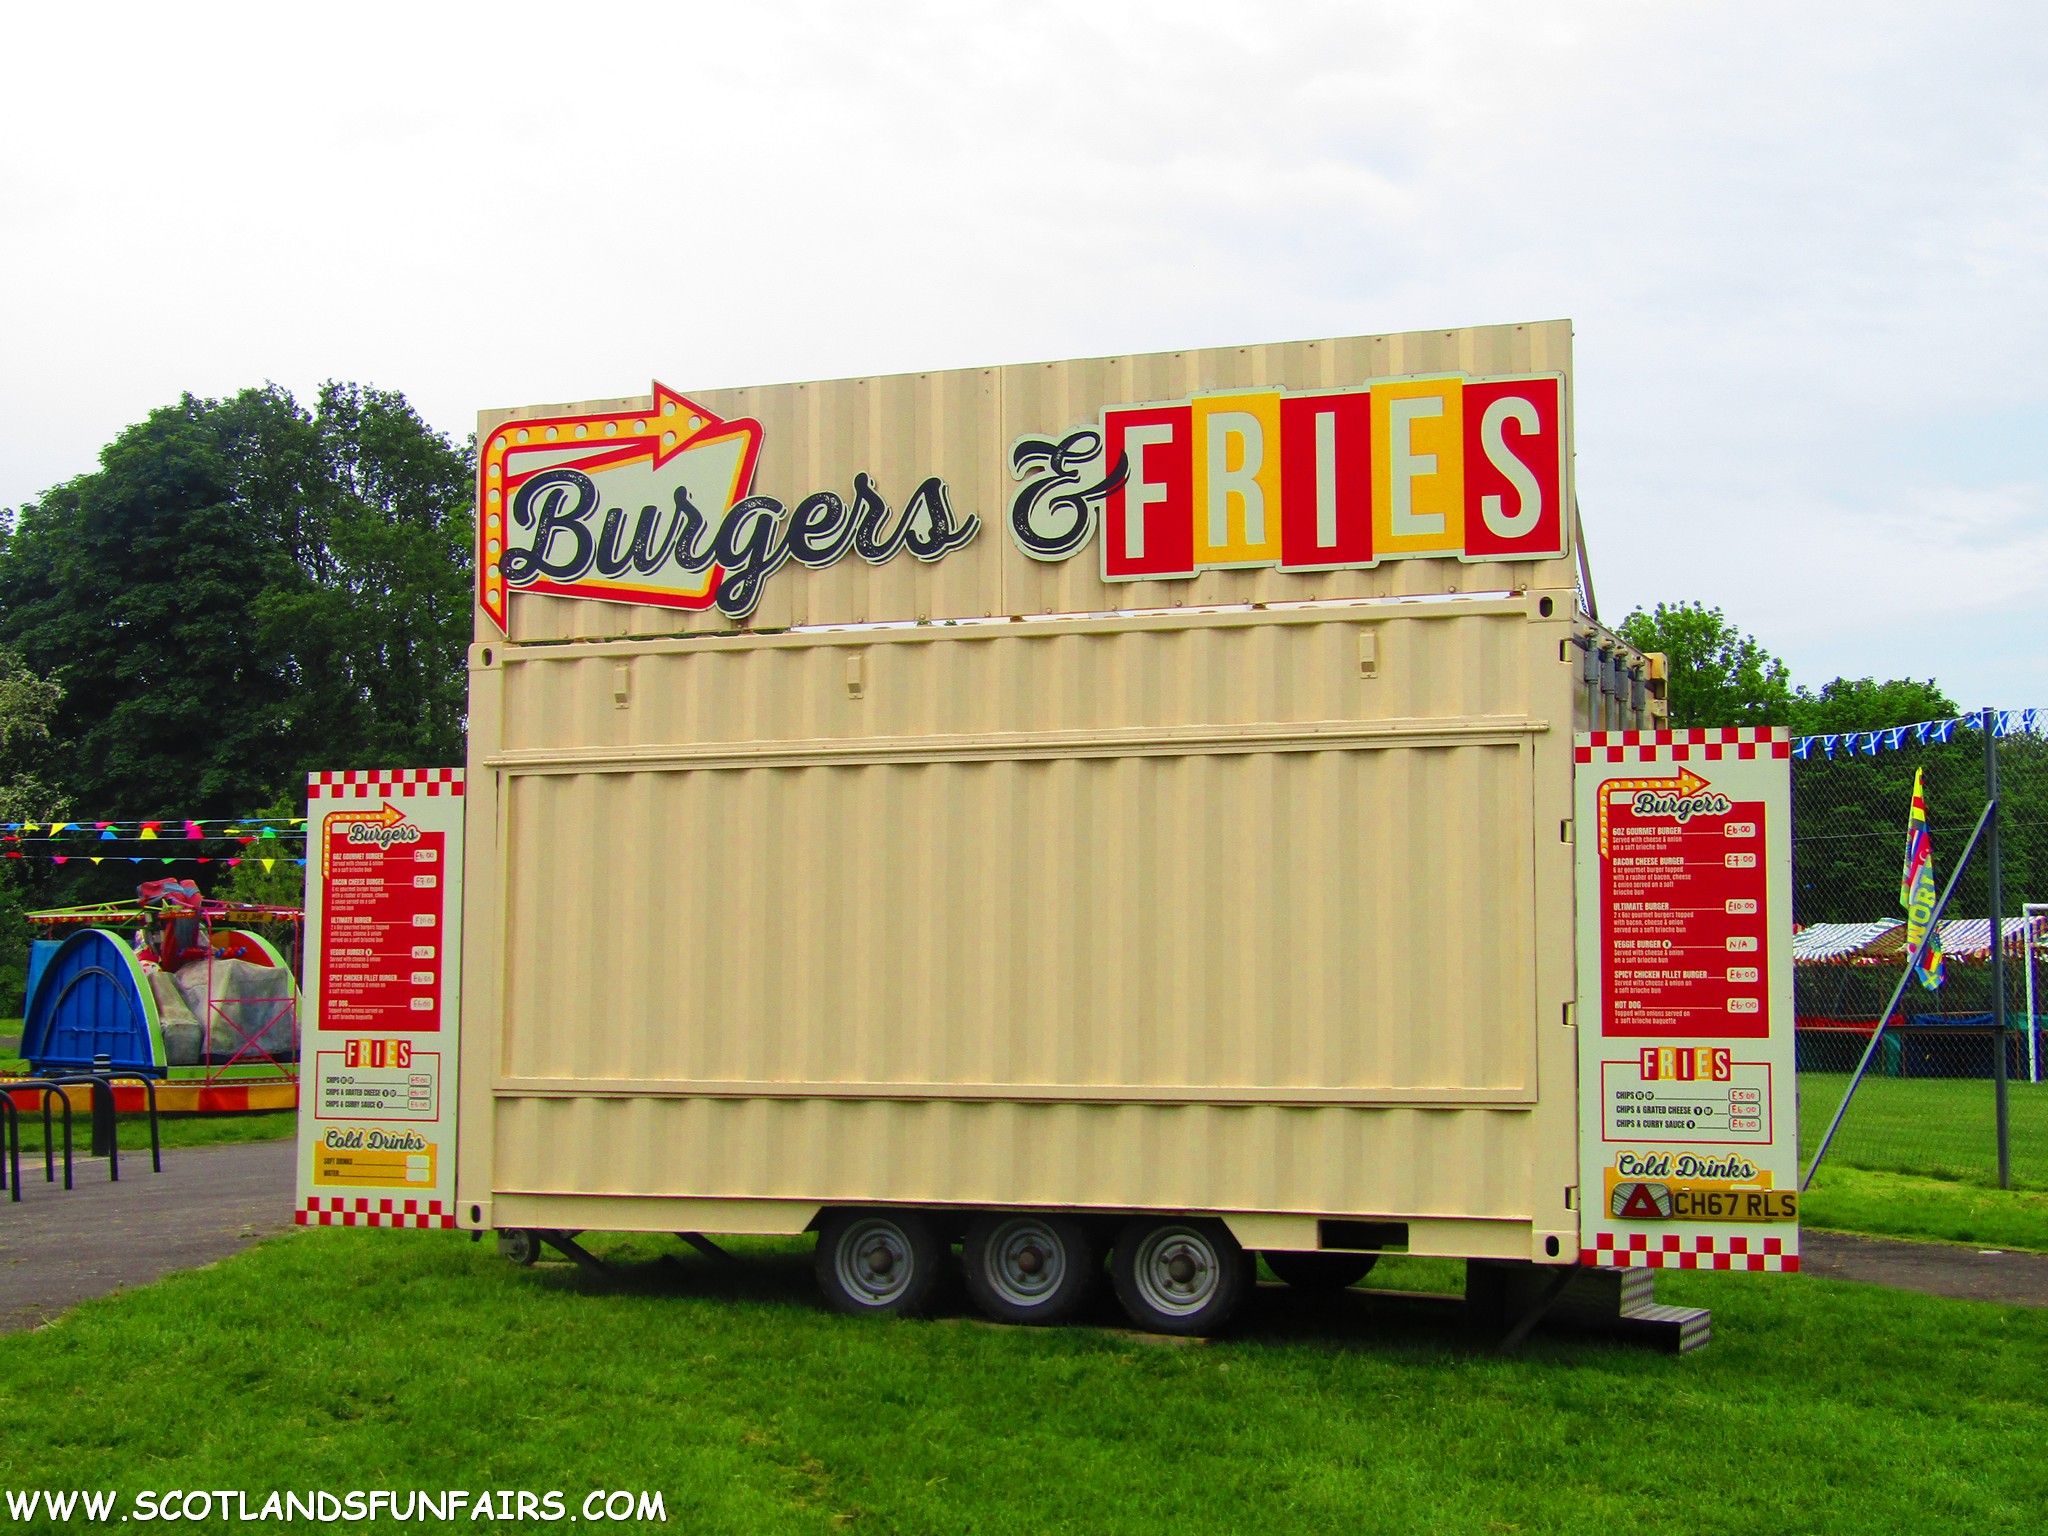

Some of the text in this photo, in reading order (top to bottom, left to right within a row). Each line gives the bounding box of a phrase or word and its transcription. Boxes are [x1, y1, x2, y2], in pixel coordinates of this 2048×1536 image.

[498, 396, 1541, 620] Burgers & FRIES
[1634, 793, 1729, 820] Burgers
[349, 824, 419, 848] Burgers
[1612, 827, 1625, 836] 6OZ
[1626, 827, 1656, 836] GOURMET
[1657, 826, 1682, 835] BURGER
[1613, 857, 1634, 866] BACON
[1635, 857, 1658, 866] CHEESE
[1660, 857, 1684, 866] BURGER
[1613, 902, 1643, 911] ULTIMATE
[1644, 902, 1669, 911] BURGER
[1613, 940, 1635, 949] VEGGIE
[1637, 940, 1661, 949] BURGER
[1614, 970, 1632, 979] SPICY
[1633, 970, 1660, 979] CHICKEN
[1661, 970, 1681, 979] FILLET
[1682, 970, 1708, 979] BURGER
[1614, 1001, 1627, 1009] HOT
[1628, 1001, 1642, 1009] DOG
[347, 1041, 410, 1066] FRIES
[1643, 1049, 1728, 1079] FRIES
[1615, 1091, 1634, 1100] CHIPS
[1616, 1105, 1635, 1114] CHIPS
[1636, 1106, 1641, 1114] &
[1642, 1106, 1666, 1114] GRATED
[1668, 1106, 1692, 1115] CHEESE
[1616, 1120, 1635, 1128] CHIPS
[1636, 1120, 1641, 1128] &
[1642, 1120, 1663, 1128] CURRY
[1664, 1120, 1685, 1129] SAUCE
[326, 1130, 426, 1150] Cold Drinks
[1619, 1154, 1756, 1178] Cold Drinks
[1674, 1192, 1796, 1216] CH67 RLS
